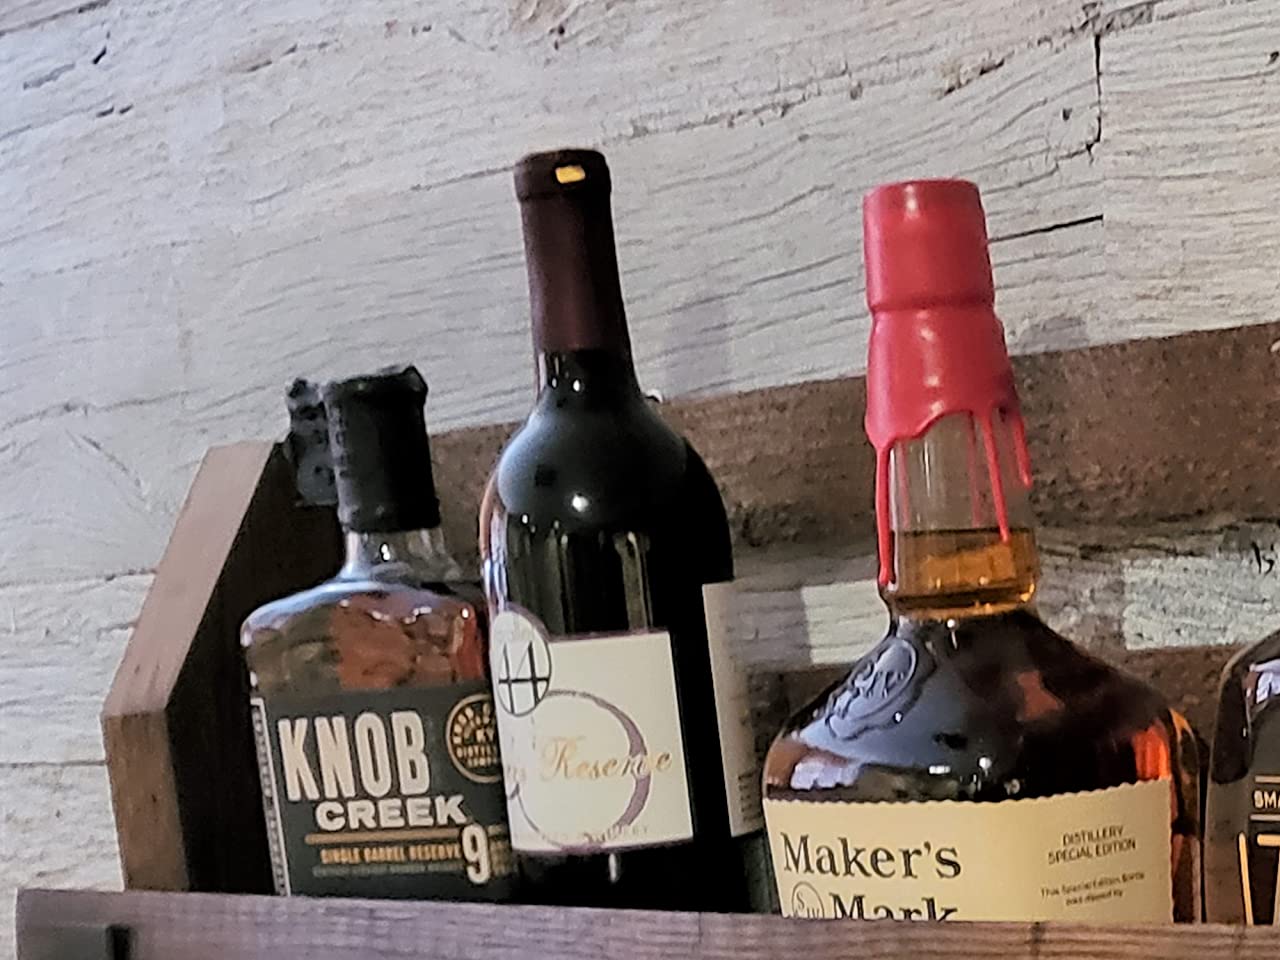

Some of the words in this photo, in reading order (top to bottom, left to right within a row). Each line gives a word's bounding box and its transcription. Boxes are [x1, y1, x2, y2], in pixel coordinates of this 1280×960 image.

[278, 710, 430, 801] KNOB
[541, 736, 673, 782] Reserve
[315, 794, 468, 831] CREEK
[1062, 825, 1124, 846] DISTILLERY
[462, 824, 491, 884] 9
[780, 832, 962, 878] Maker's
[1047, 845, 1093, 865] SPECIAL
[1095, 837, 1136, 857] EDITION
